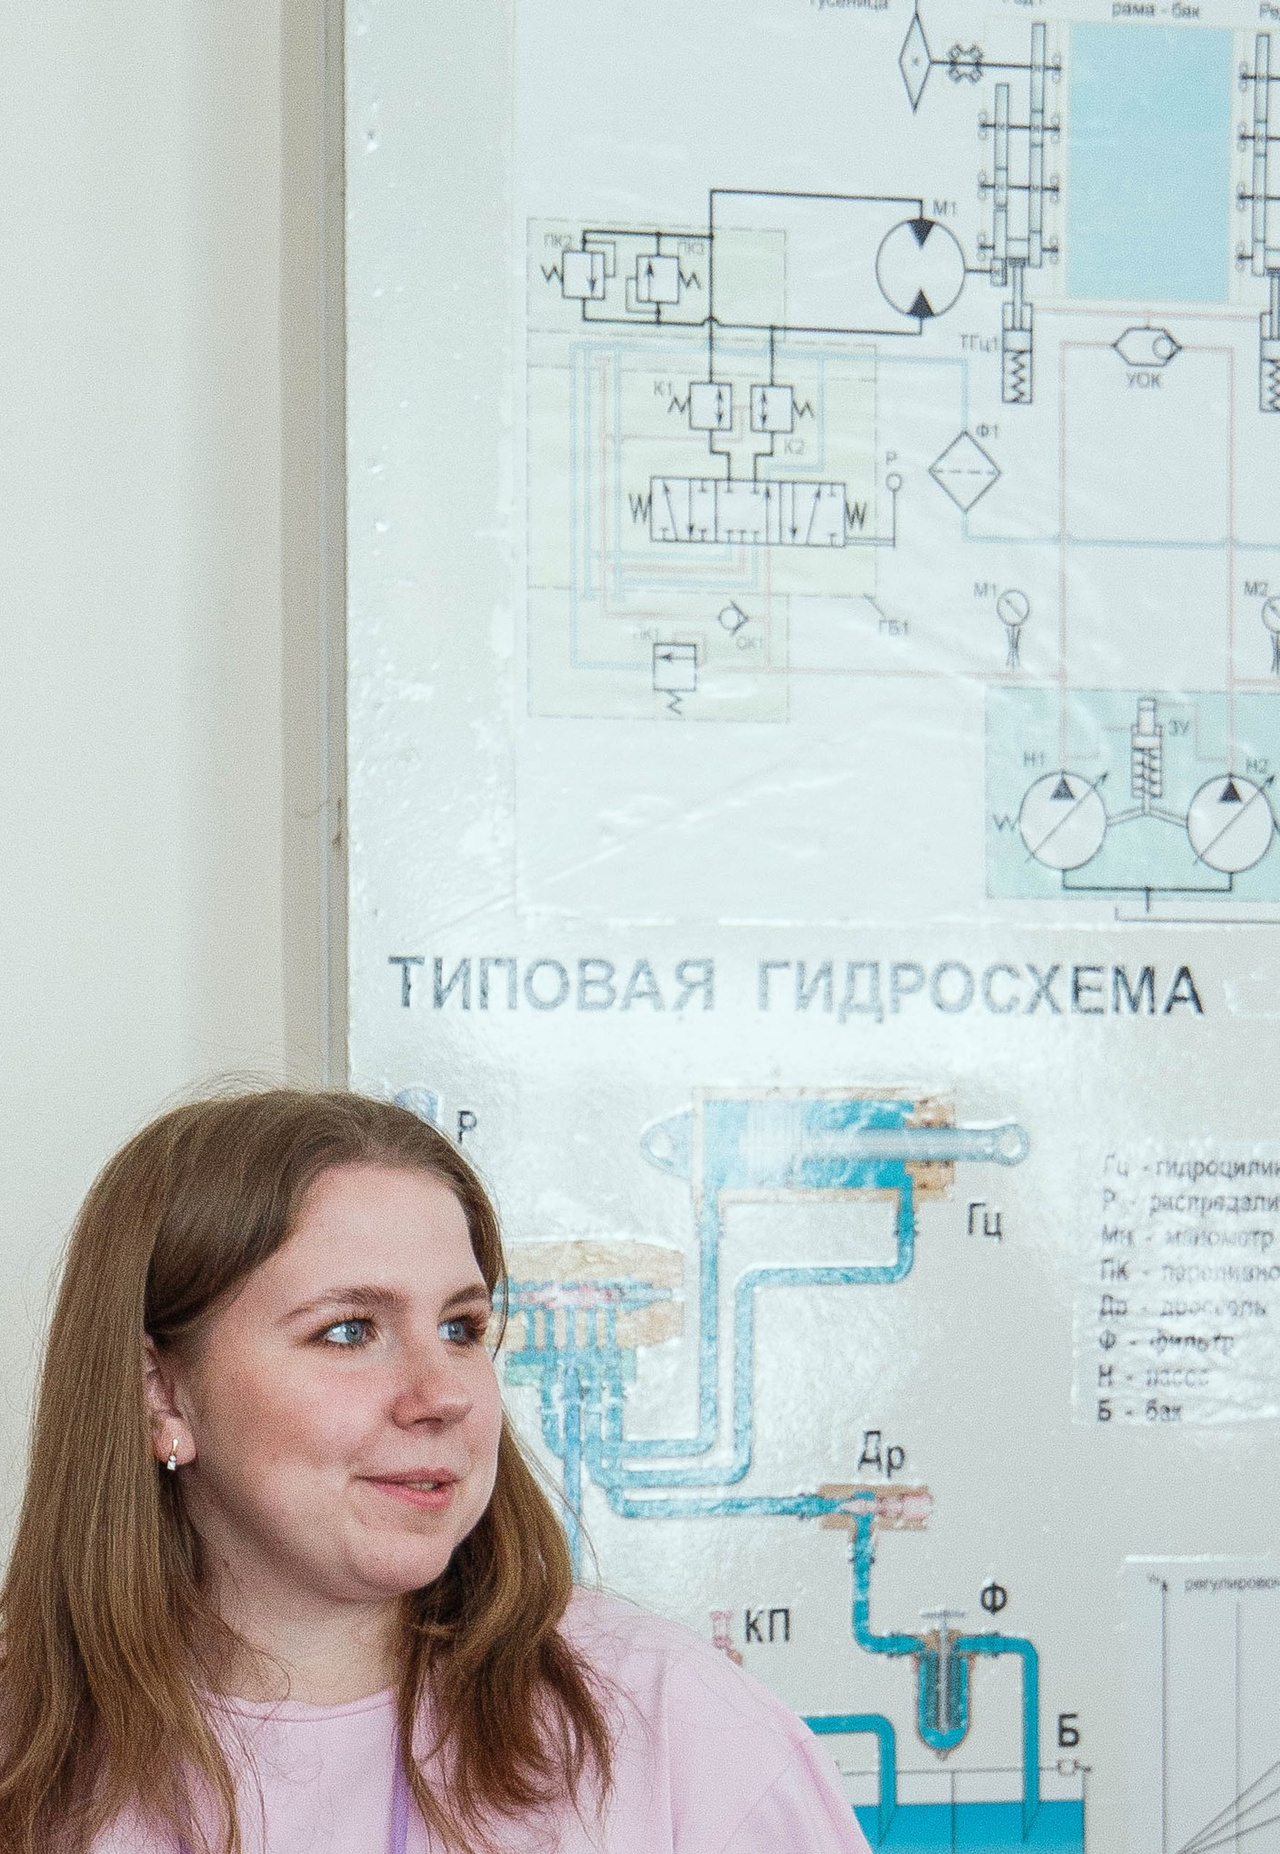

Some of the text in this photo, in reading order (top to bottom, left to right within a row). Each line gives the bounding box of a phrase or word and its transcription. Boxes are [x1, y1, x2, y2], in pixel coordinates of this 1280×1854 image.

[932, 201, 958, 216] М1
[1126, 371, 1163, 390] УОК
[783, 438, 805, 456] К2
[388, 955, 1206, 1022] ТИПОВАЯ ГИДРОСХЕМА
[458, 1110, 478, 1145] Р
[966, 1202, 1004, 1242] Гц
[1097, 1398, 1112, 1421] Б
[857, 1430, 906, 1477] Др
[979, 1583, 1008, 1613] Ф
[745, 1608, 791, 1643] КП
[1058, 1715, 1080, 1748] Б
